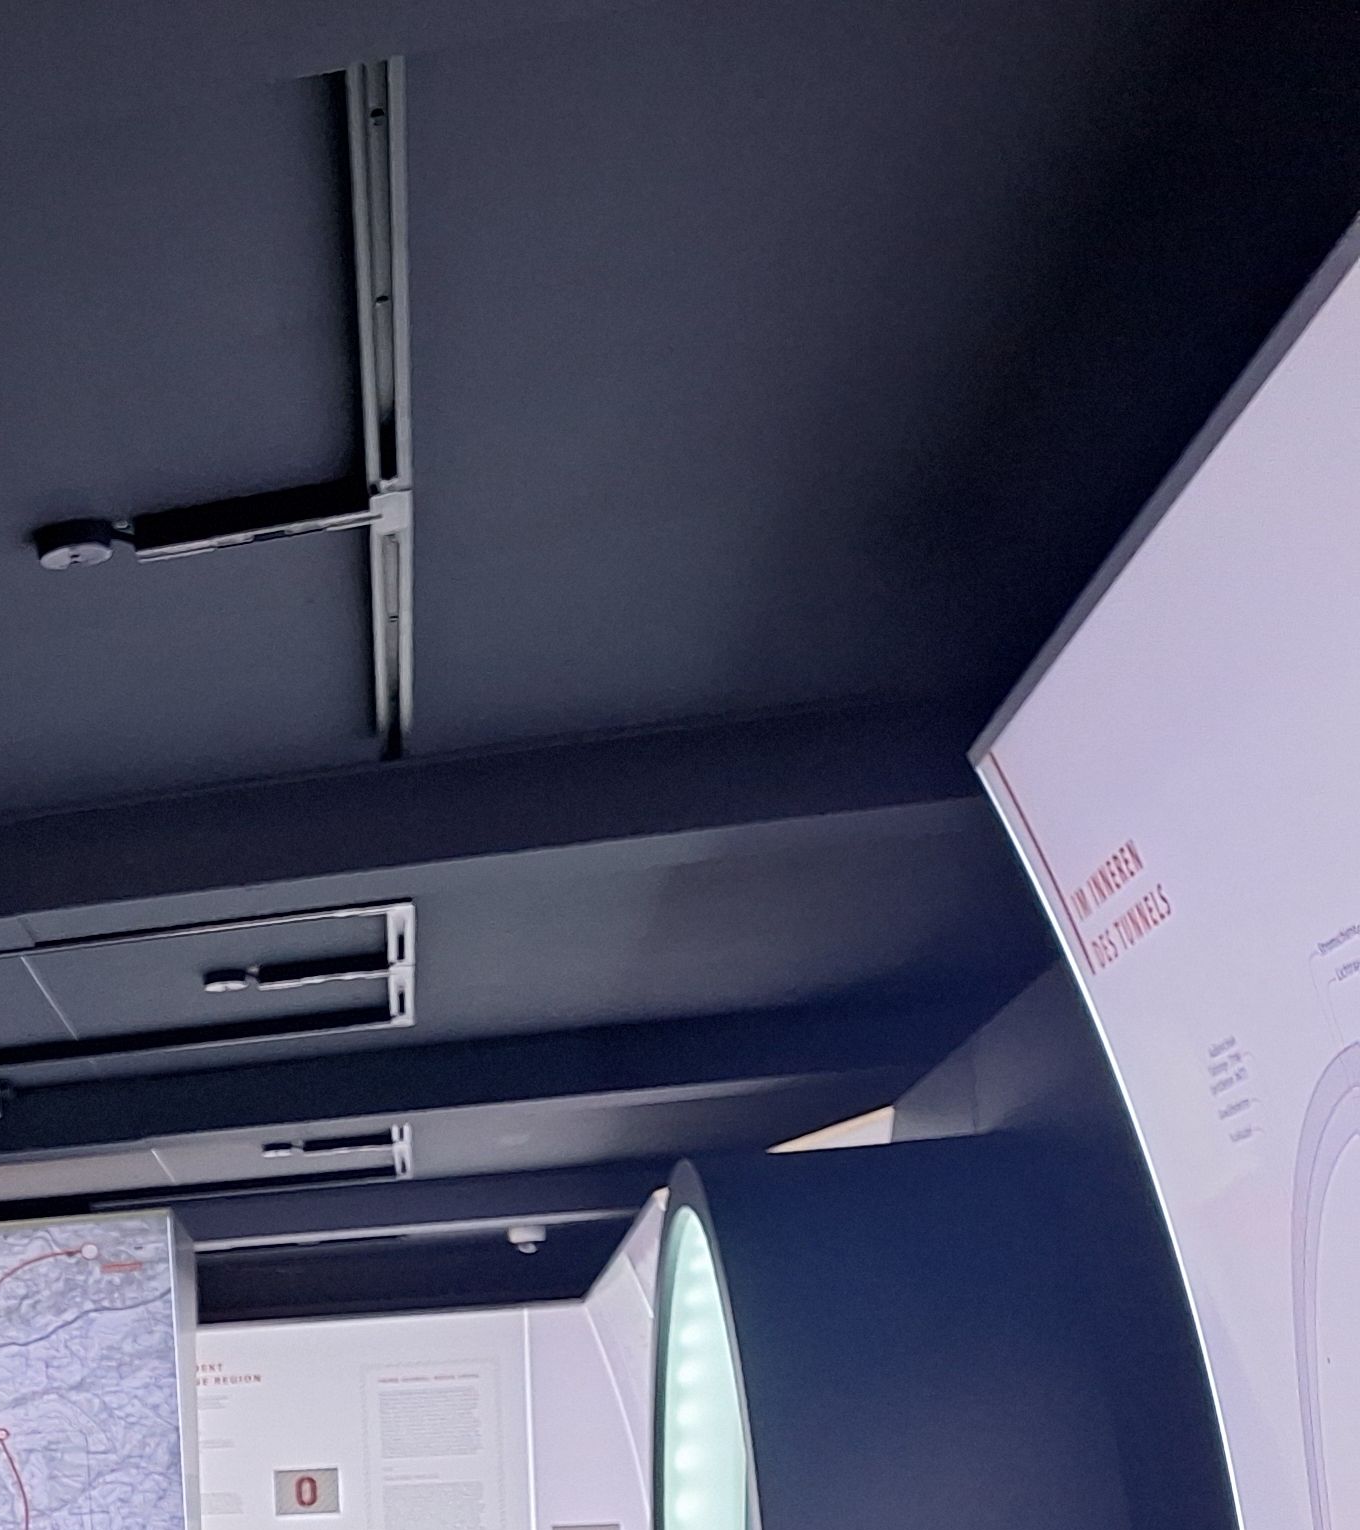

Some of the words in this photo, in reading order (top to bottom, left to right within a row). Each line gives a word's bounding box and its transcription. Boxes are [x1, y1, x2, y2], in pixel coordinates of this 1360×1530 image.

[1070, 887, 1093, 922] IM
[1086, 838, 1144, 907] INNEREN
[1091, 929, 1119, 969] DES
[1112, 883, 1172, 950] TUNNELS
[214, 1374, 262, 1386] REGION
[295, 1476, 319, 1508] 0
